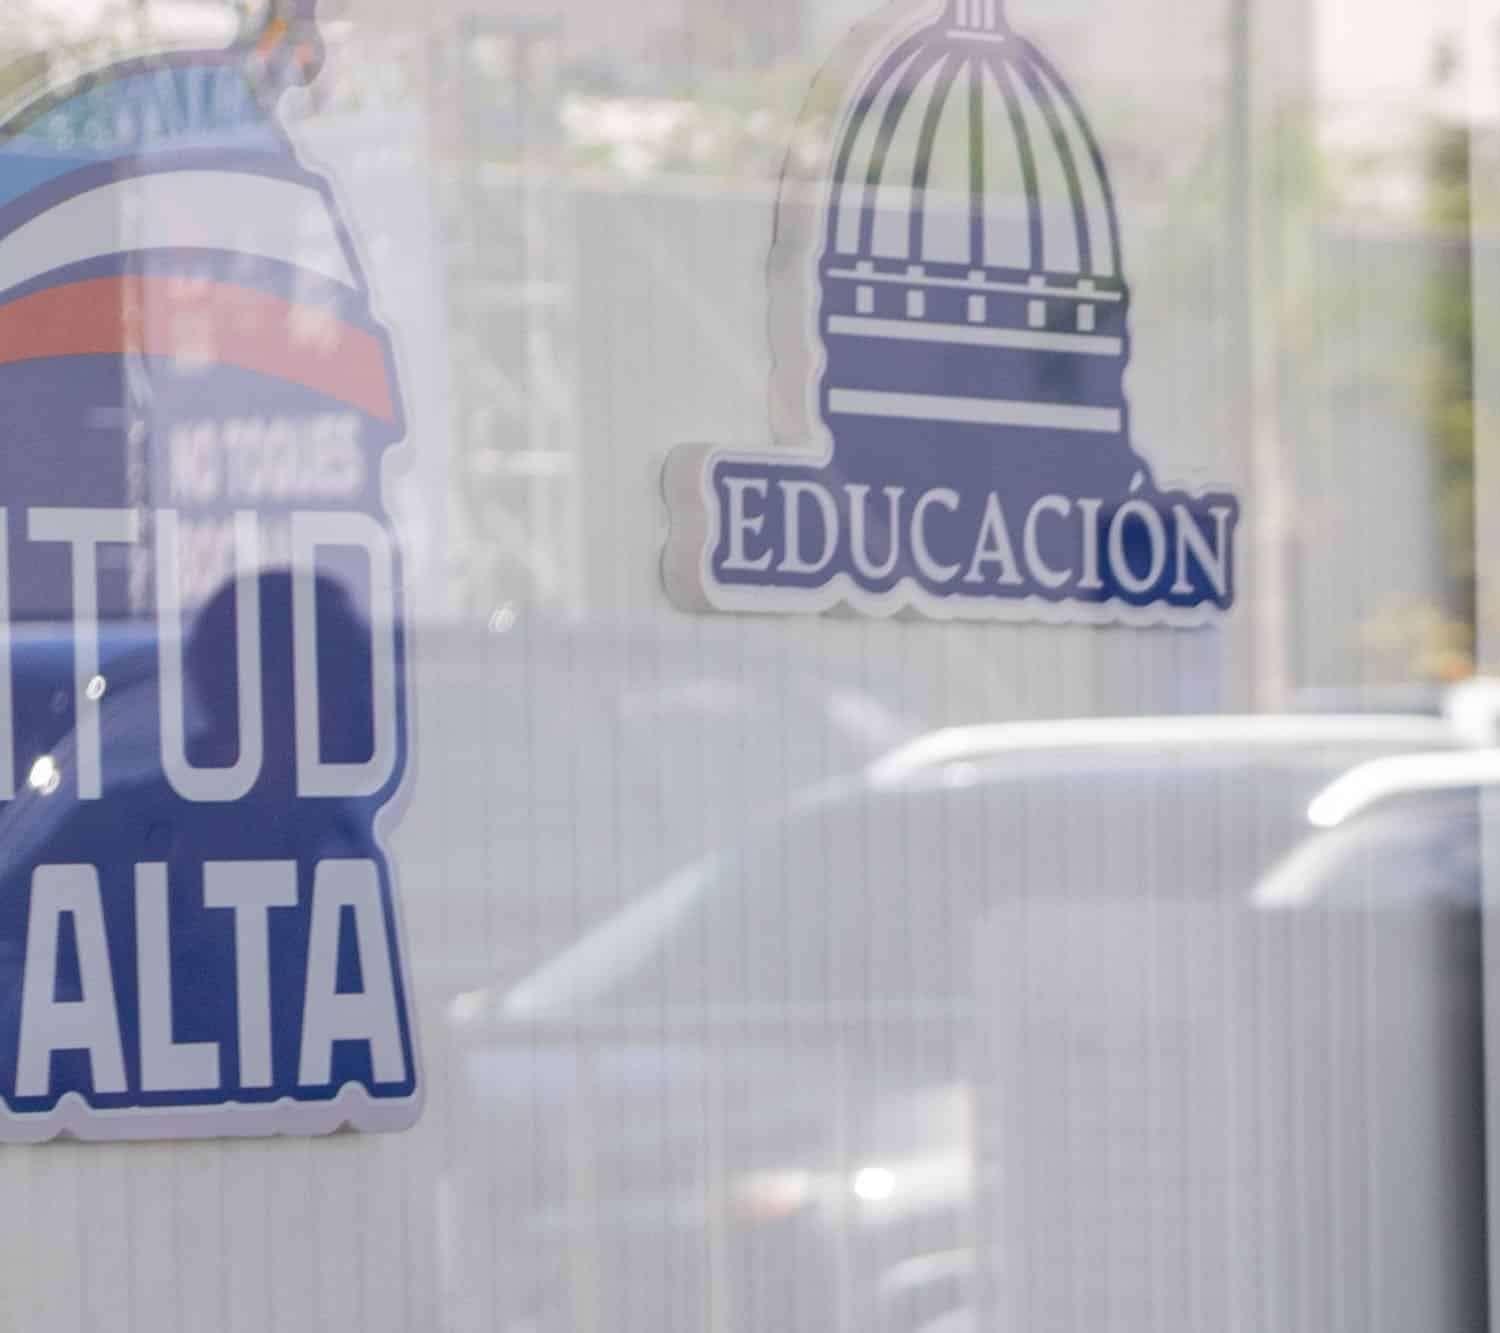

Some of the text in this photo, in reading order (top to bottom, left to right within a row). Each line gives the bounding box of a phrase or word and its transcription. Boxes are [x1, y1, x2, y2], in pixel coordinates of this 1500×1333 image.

[0, 506, 398, 803] TUD
[721, 471, 1232, 598] EDUCACIÓN
[14, 857, 408, 1098] ALTA
